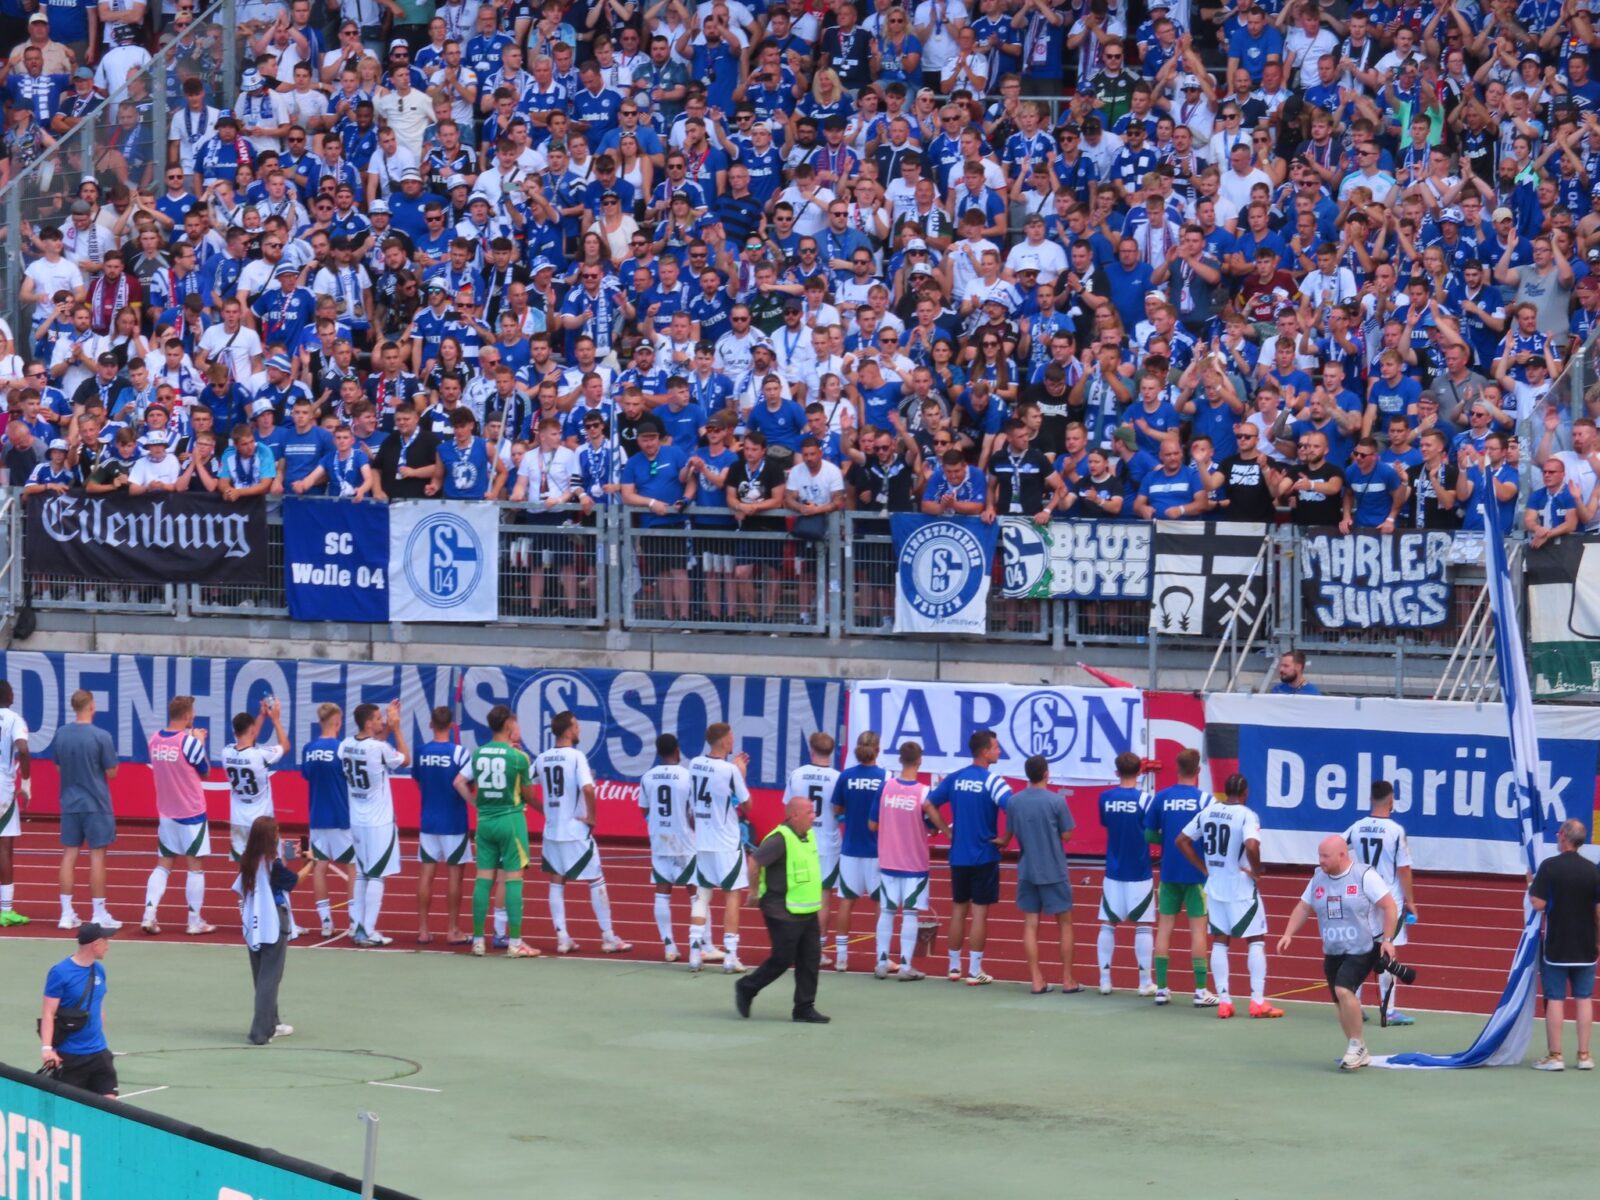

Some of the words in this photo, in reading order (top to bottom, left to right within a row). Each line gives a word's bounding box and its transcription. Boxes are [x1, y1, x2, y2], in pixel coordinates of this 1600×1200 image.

[41, 495, 249, 558] Eilenburg
[324, 531, 353, 555] SC
[1051, 522, 1150, 560] BLUE
[1301, 531, 1452, 586] MARLER
[291, 562, 352, 587] Wolle
[356, 568, 385, 590] 04
[433, 570, 455, 595] 04
[1051, 560, 1149, 596] BOYZ
[913, 594, 963, 616] VEREIN
[1316, 583, 1448, 628] JUNGS
[306, 749, 334, 762] HRS
[420, 755, 451, 767] HRS
[227, 767, 259, 796] 23
[342, 757, 370, 790] 35
[476, 757, 507, 790] 28
[544, 765, 565, 798] 19
[848, 778, 882, 791] HRS
[954, 779, 984, 793] HRS
[1266, 747, 1573, 823] Delbrück
[657, 784, 672, 817] 9
[692, 774, 713, 808] 14
[808, 785, 823, 818] 5
[884, 794, 917, 812] HRS
[1104, 800, 1137, 813] HRS
[1163, 798, 1197, 812] HRS
[1203, 821, 1231, 857] 30
[1360, 837, 1383, 868] 17
[0, 1109, 82, 1200] FREI
